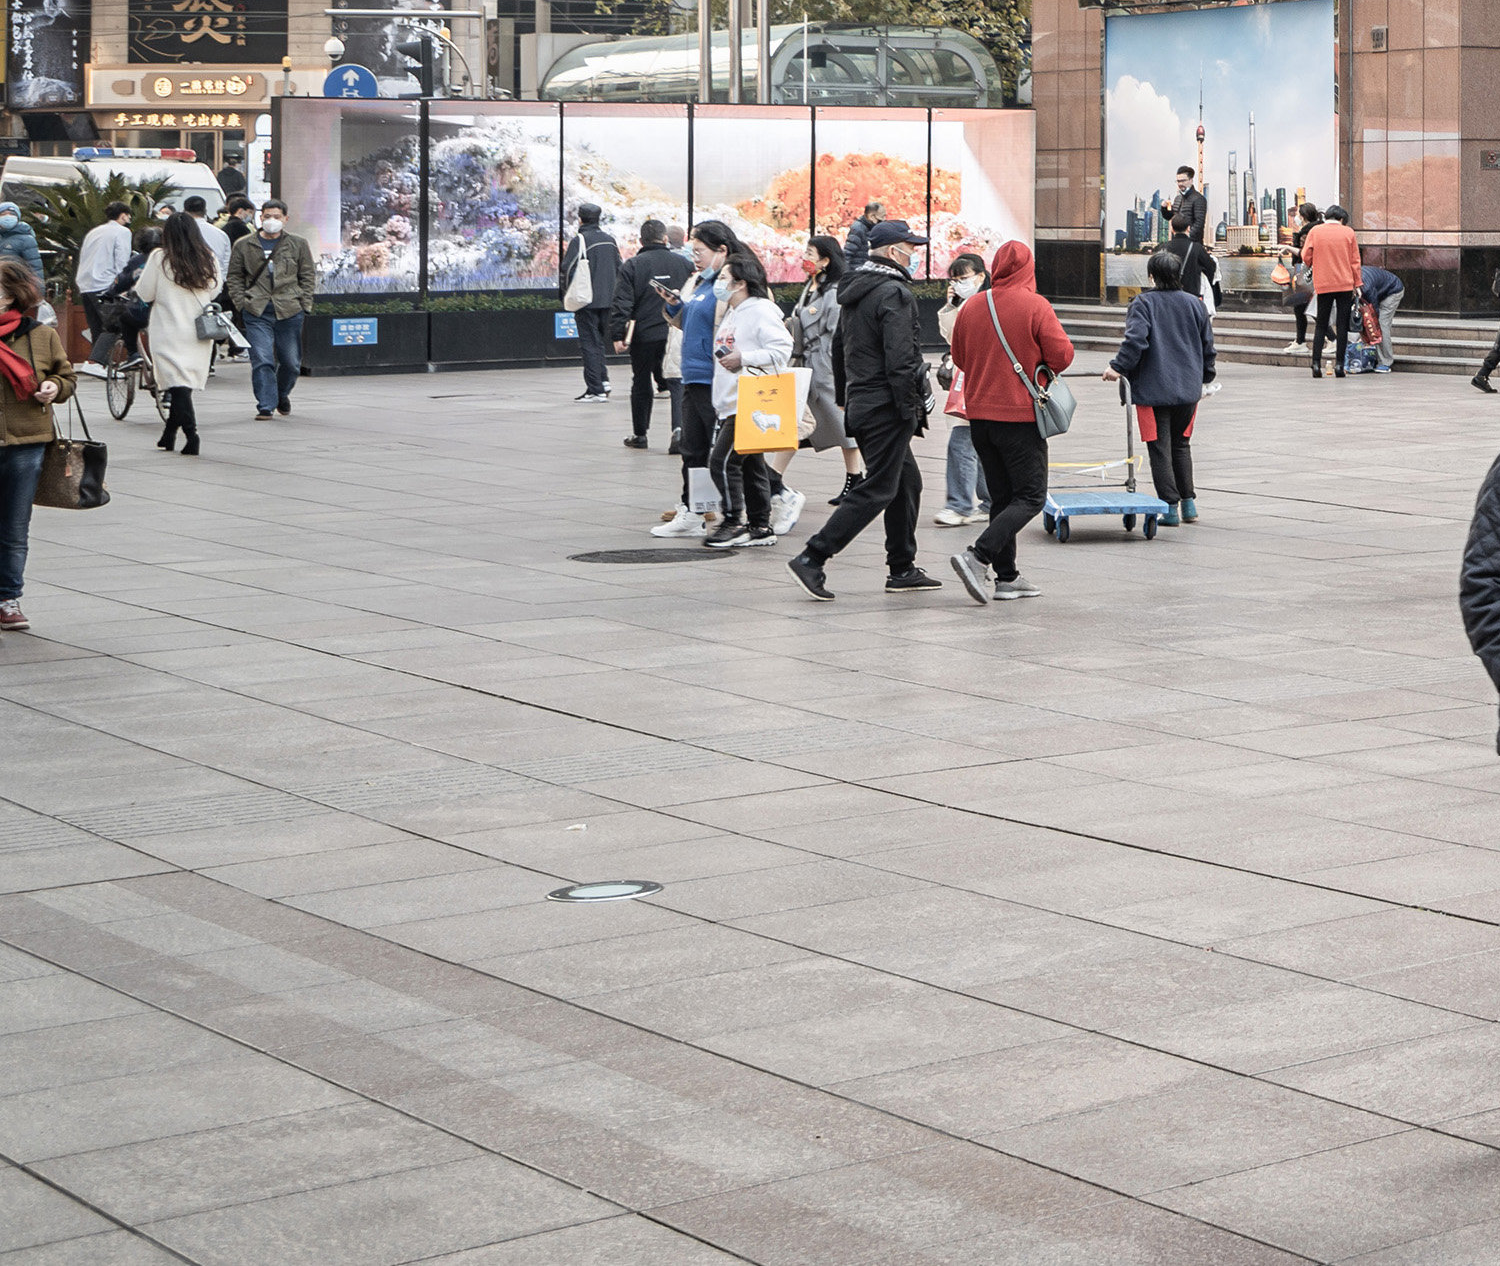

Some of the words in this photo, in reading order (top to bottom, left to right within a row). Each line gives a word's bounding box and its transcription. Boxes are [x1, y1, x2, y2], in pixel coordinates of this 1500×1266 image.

[114, 113, 177, 127] 手工现做
[182, 113, 242, 127] 吃出健康
